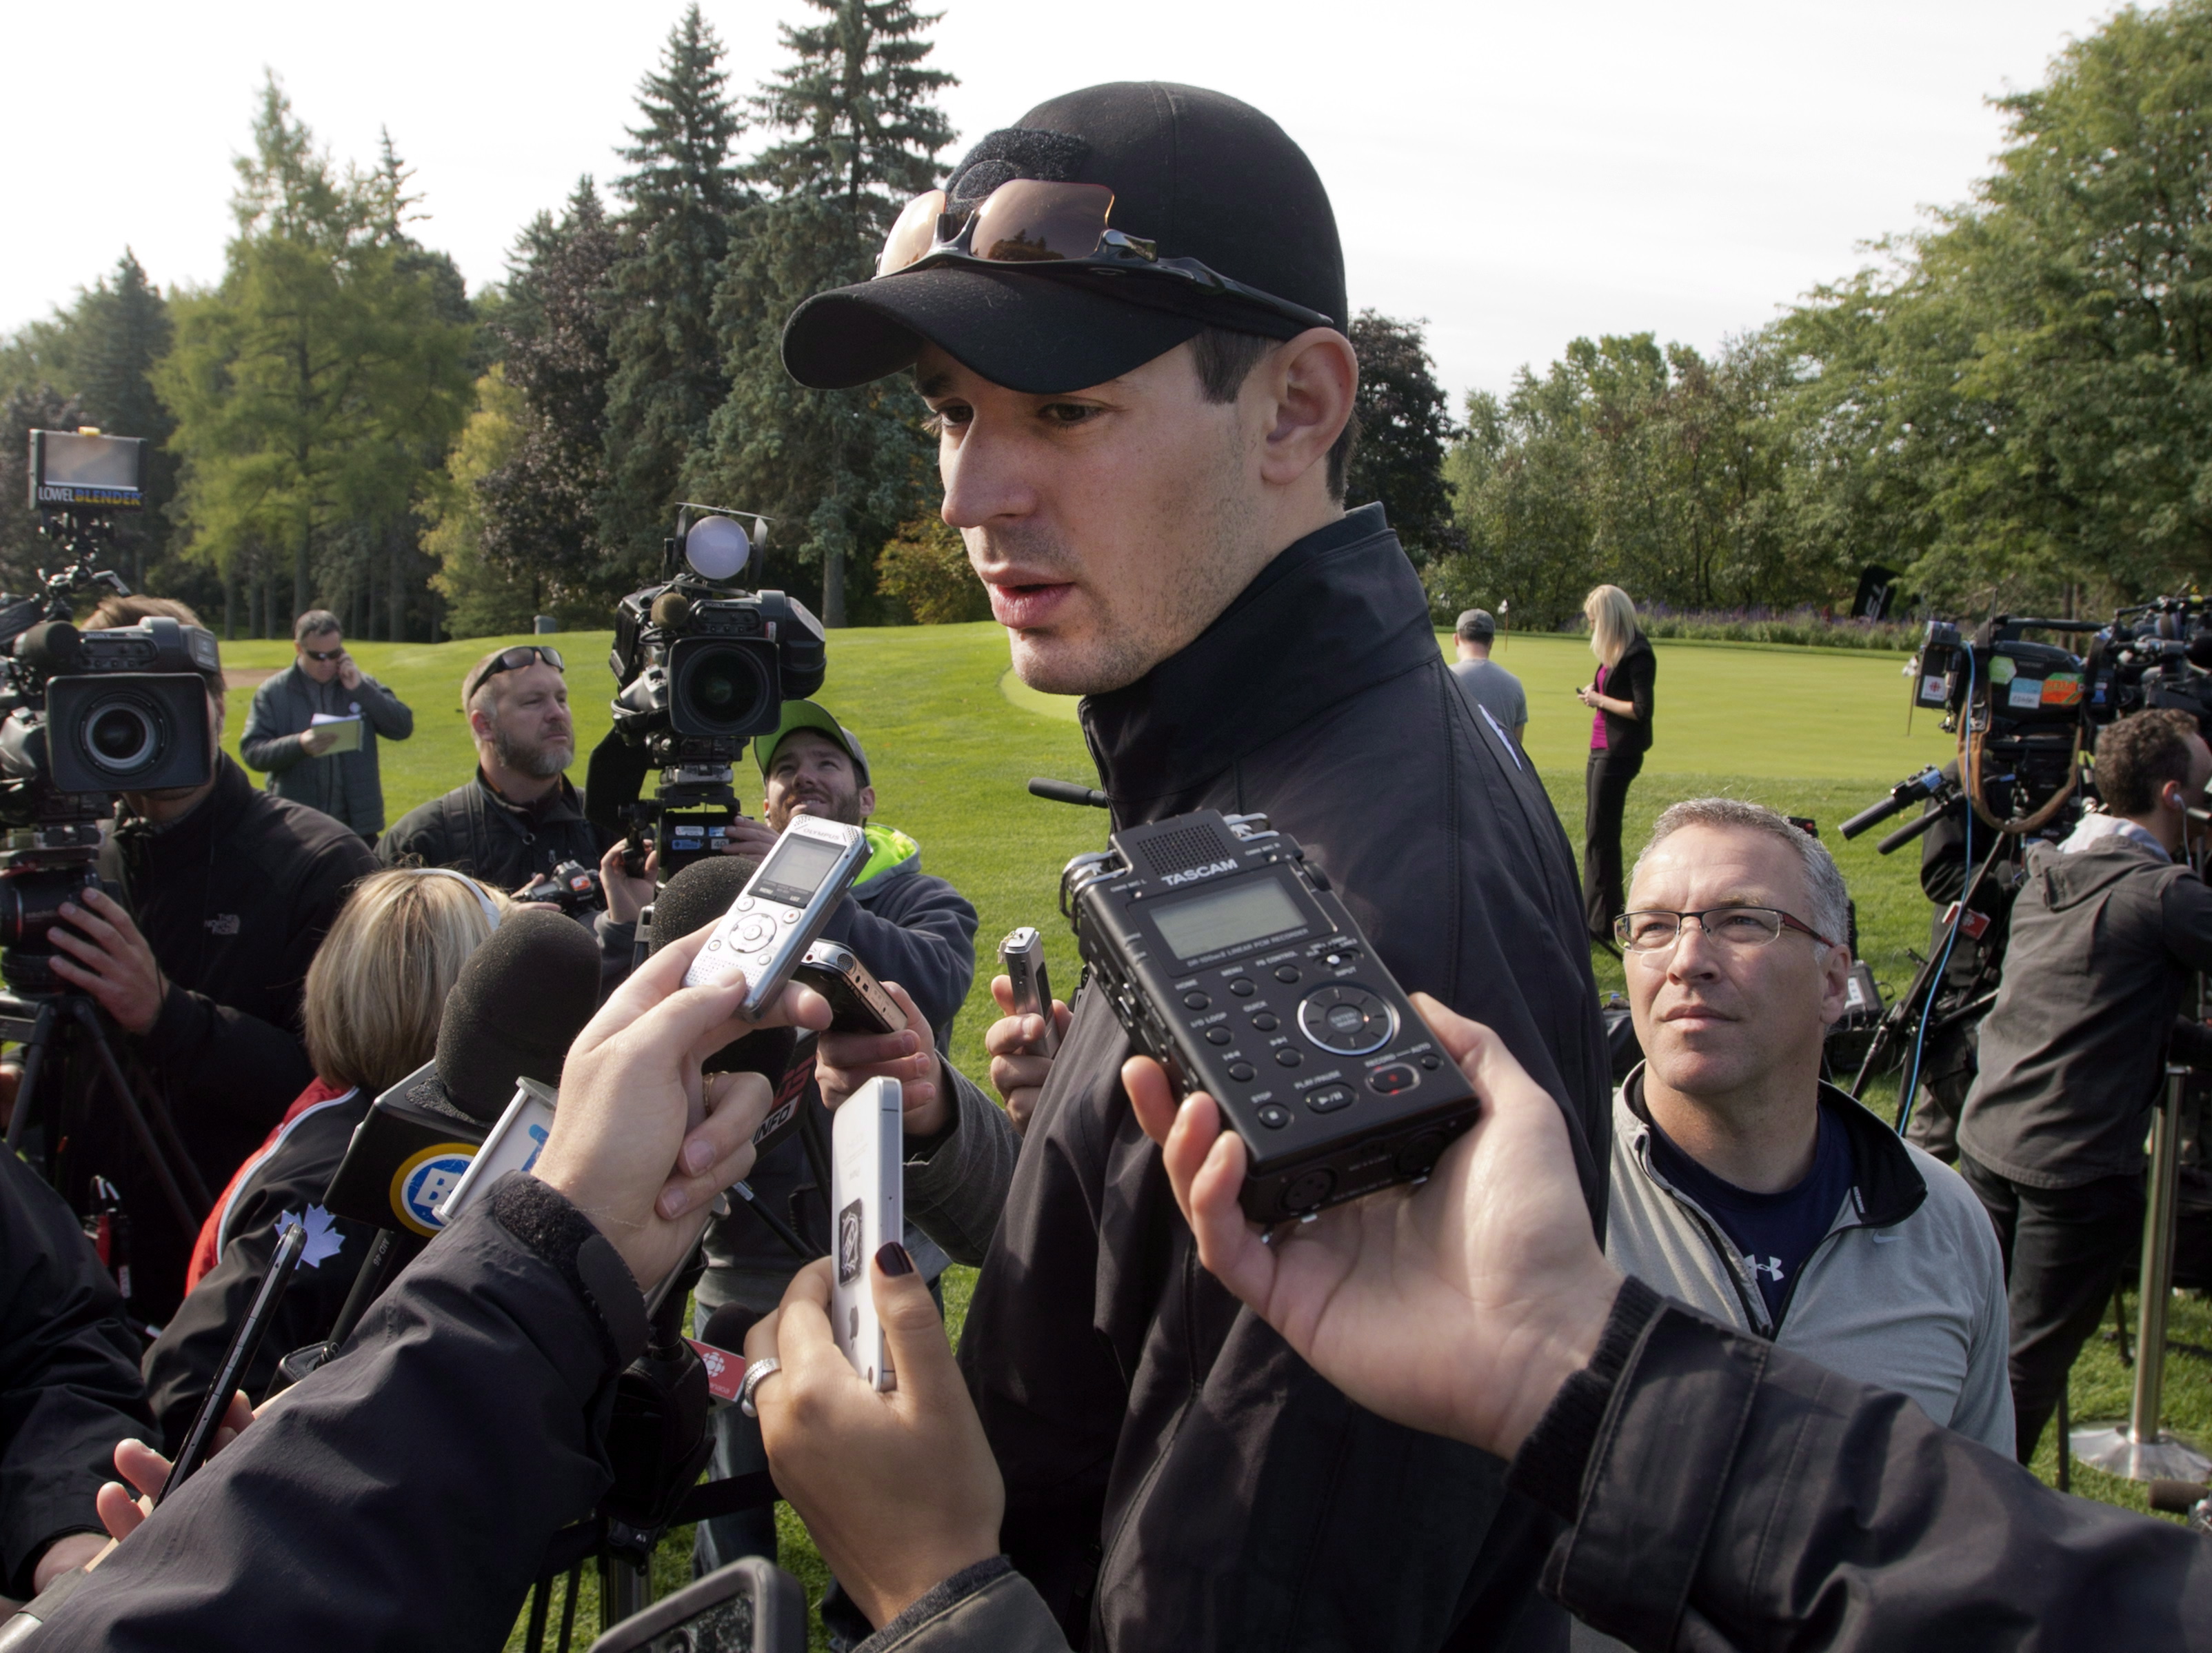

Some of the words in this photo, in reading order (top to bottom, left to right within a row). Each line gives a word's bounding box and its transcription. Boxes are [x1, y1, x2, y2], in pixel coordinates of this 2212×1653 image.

[803, 828, 840, 841] OLYMPUS
[1161, 858, 1238, 885] TASCAM
[1227, 944, 1254, 956] LINEAR
[1254, 939, 1271, 949] PCM
[1271, 928, 1309, 943] RECORDER
[1267, 950, 1298, 964] CONTROL
[1220, 965, 1244, 976] MENU
[1334, 966, 1356, 977] INPUT
[1175, 979, 1198, 990] HOME
[1243, 1001, 1268, 1012] QUICK
[1205, 1012, 1227, 1025] LOOP
[1364, 1052, 1396, 1068] RECORD
[1411, 1042, 1431, 1054] AUTO
[1294, 1070, 1342, 1090] PLAY/PAUSE
[1251, 1091, 1272, 1103] STOP
[753, 1103, 792, 1144] INFO
